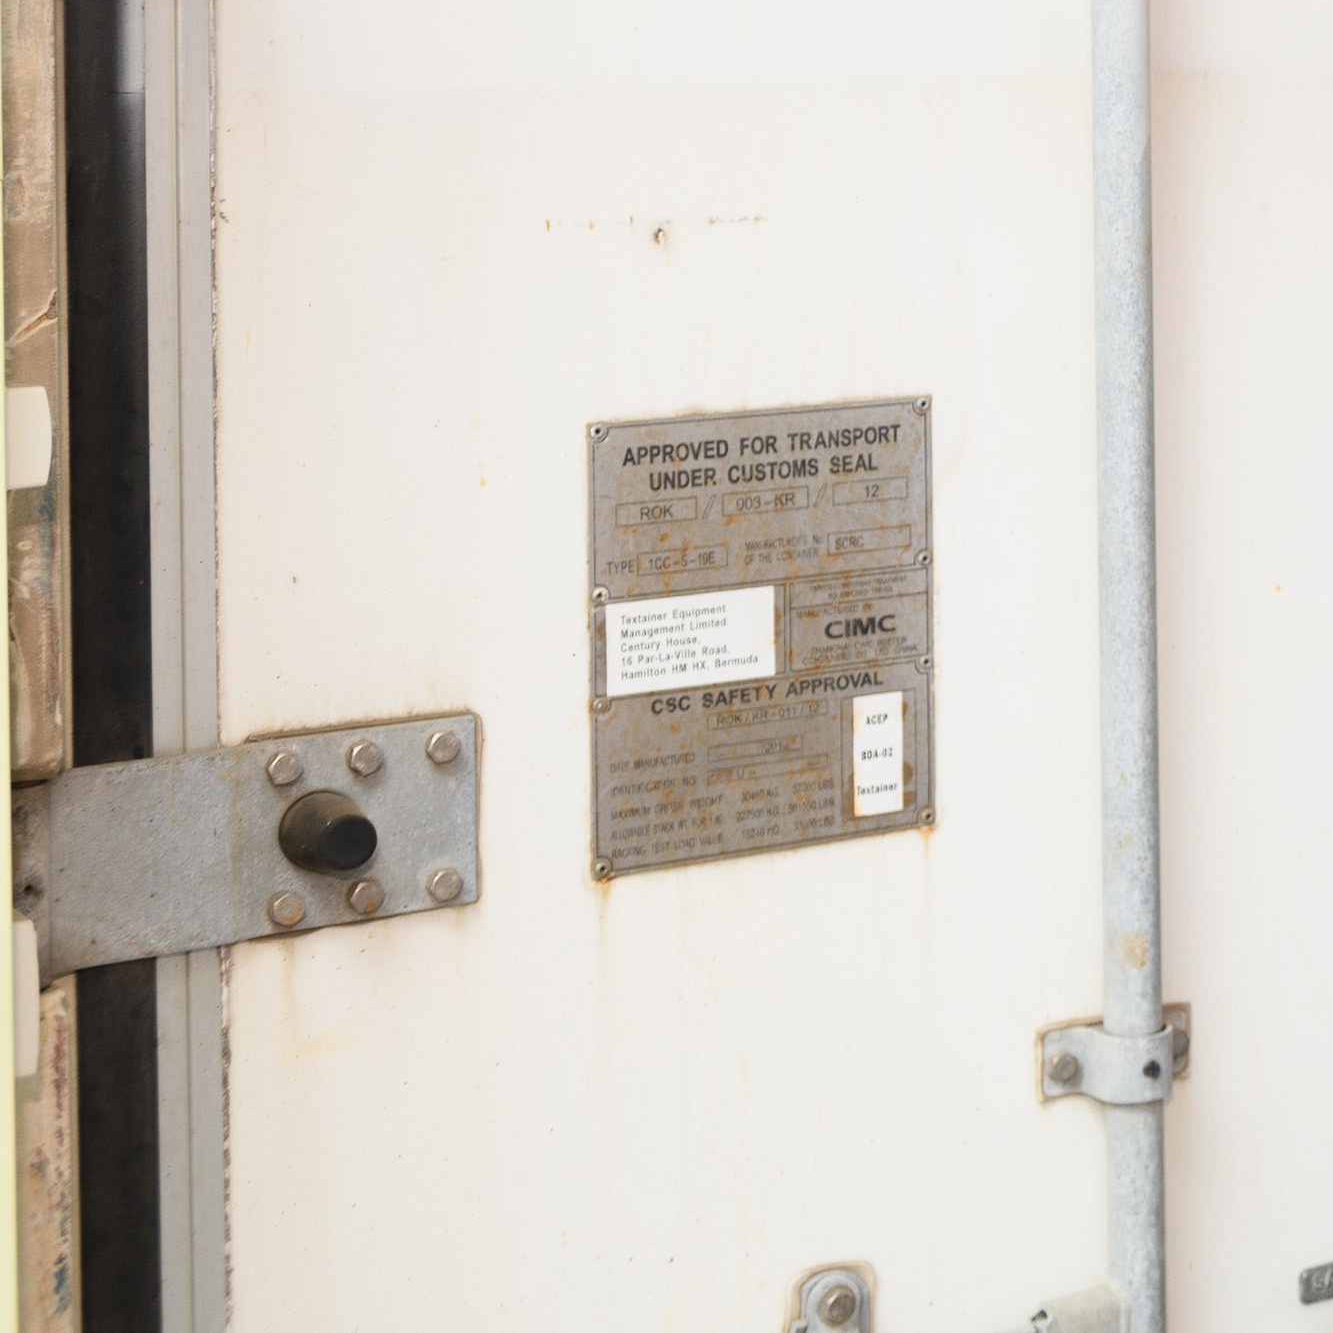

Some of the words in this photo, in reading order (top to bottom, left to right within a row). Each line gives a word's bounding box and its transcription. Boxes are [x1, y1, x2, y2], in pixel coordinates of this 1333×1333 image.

[622, 439, 729, 467] APPROVED
[739, 435, 778, 456] FOR
[787, 424, 901, 452] TRANSPORT
[649, 467, 717, 491] UNDER
[727, 458, 819, 484] CUSTOMS
[829, 452, 879, 475] SEAL
[640, 504, 674, 520] ROK
[865, 483, 880, 499] 12
[606, 559, 635, 576] TYPE
[620, 611, 667, 626] Textainer
[672, 604, 727, 620] Equipment
[620, 623, 685, 639] Management
[689, 618, 727, 631] Limited
[824, 613, 896, 640] CIMC
[620, 639, 661, 653] Century
[620, 667, 667, 681] Hamilton
[671, 662, 687, 674] HM
[714, 653, 759, 668] Bermuda
[621, 655, 633, 666] 16
[637, 649, 697, 665] Par-La-Ville
[650, 694, 691, 715] CSC
[701, 684, 777, 709] SAFETY
[785, 671, 884, 699] APPROVAL
[865, 713, 888, 726] ACEP
[857, 782, 898, 796] Textainer
